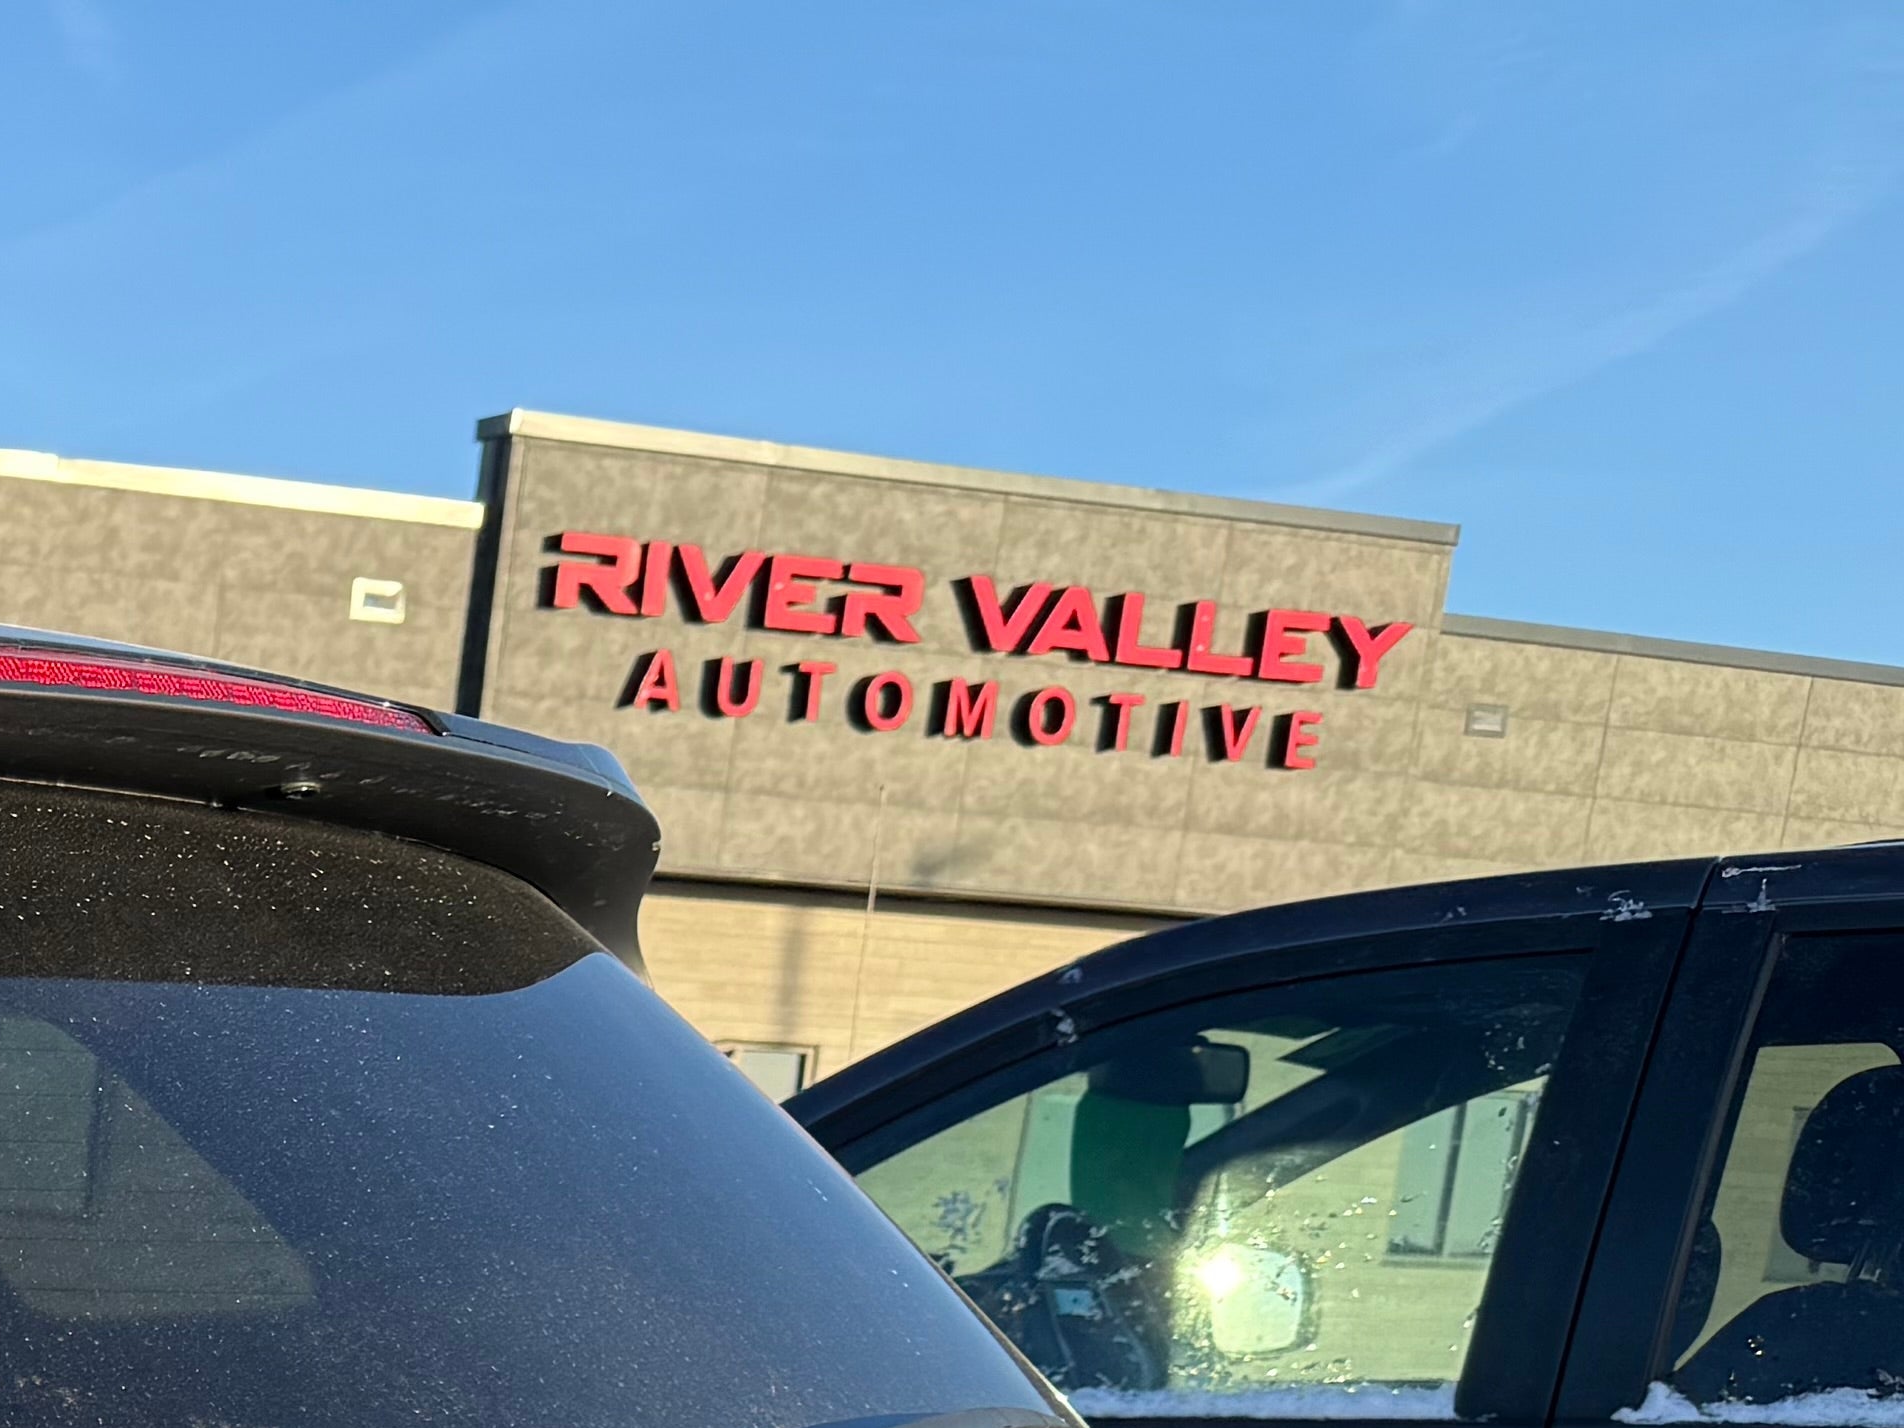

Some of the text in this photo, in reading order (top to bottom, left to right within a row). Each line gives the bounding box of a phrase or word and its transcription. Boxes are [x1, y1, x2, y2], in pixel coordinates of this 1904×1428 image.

[550, 531, 1415, 690] RIVER VALLEY
[630, 648, 1324, 770] AUTOMOTIVE
